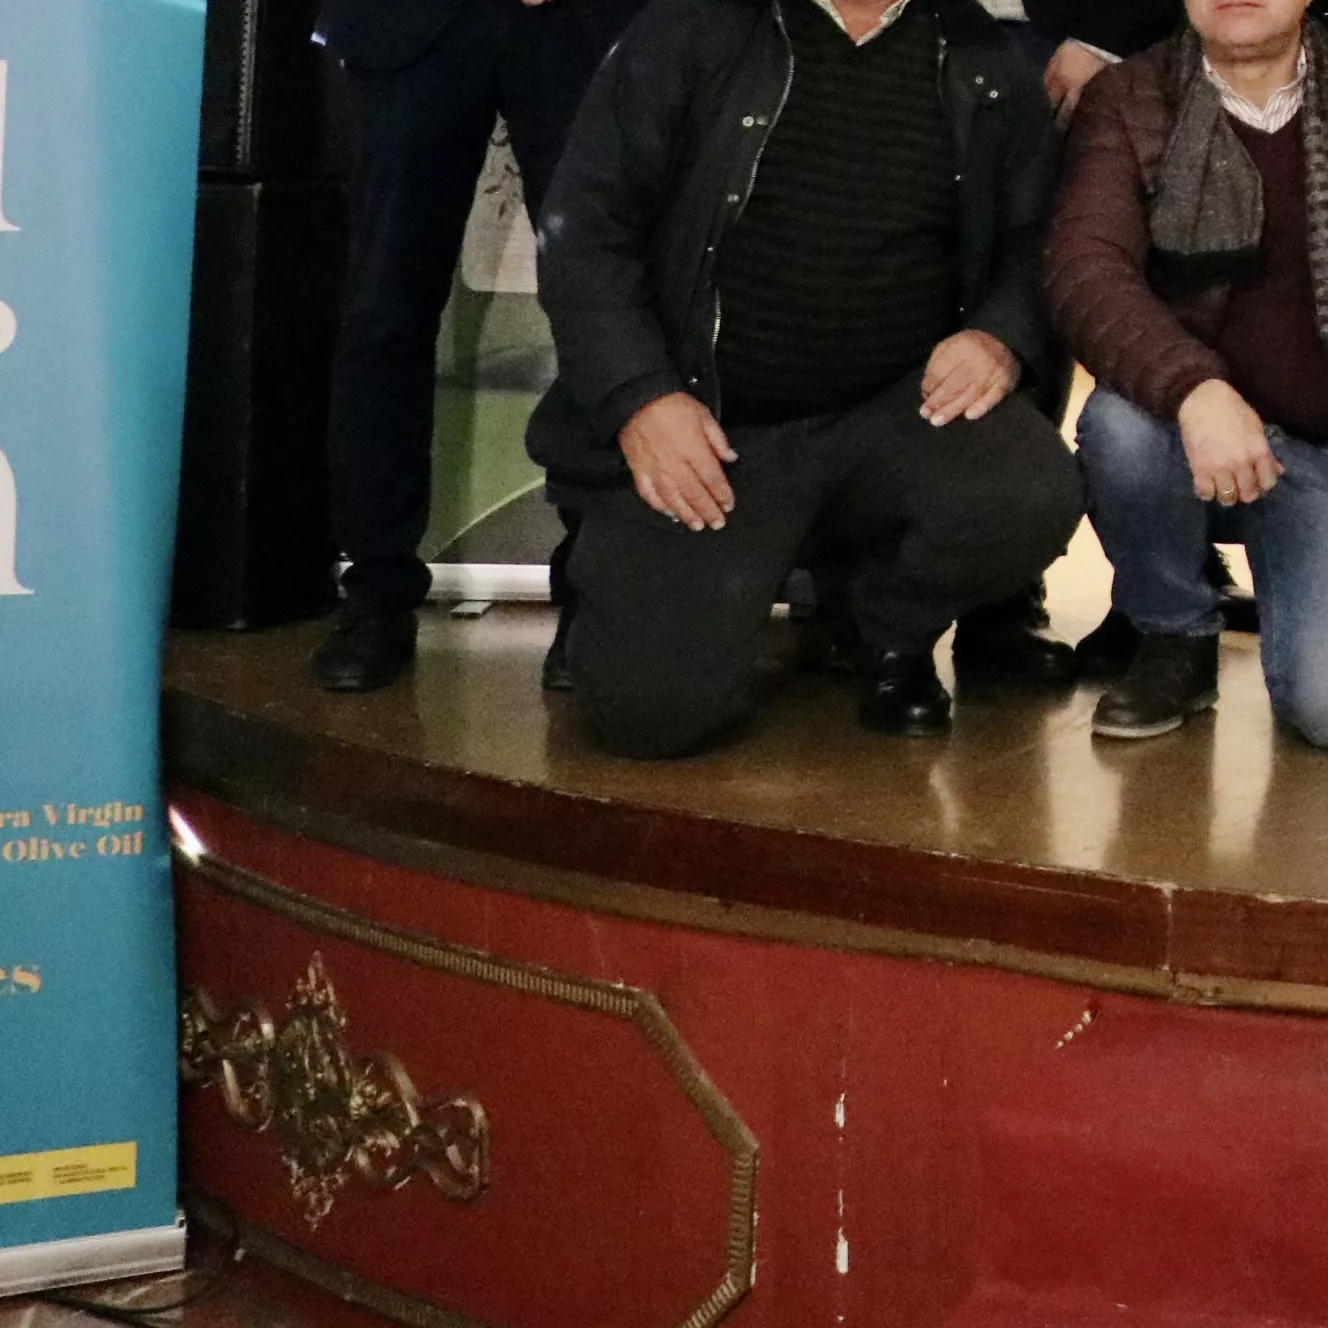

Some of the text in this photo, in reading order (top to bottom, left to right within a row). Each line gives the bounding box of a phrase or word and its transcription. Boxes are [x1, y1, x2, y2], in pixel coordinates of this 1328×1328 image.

[43, 801, 144, 828] Virgin
[3, 830, 144, 862] Olive Oil
